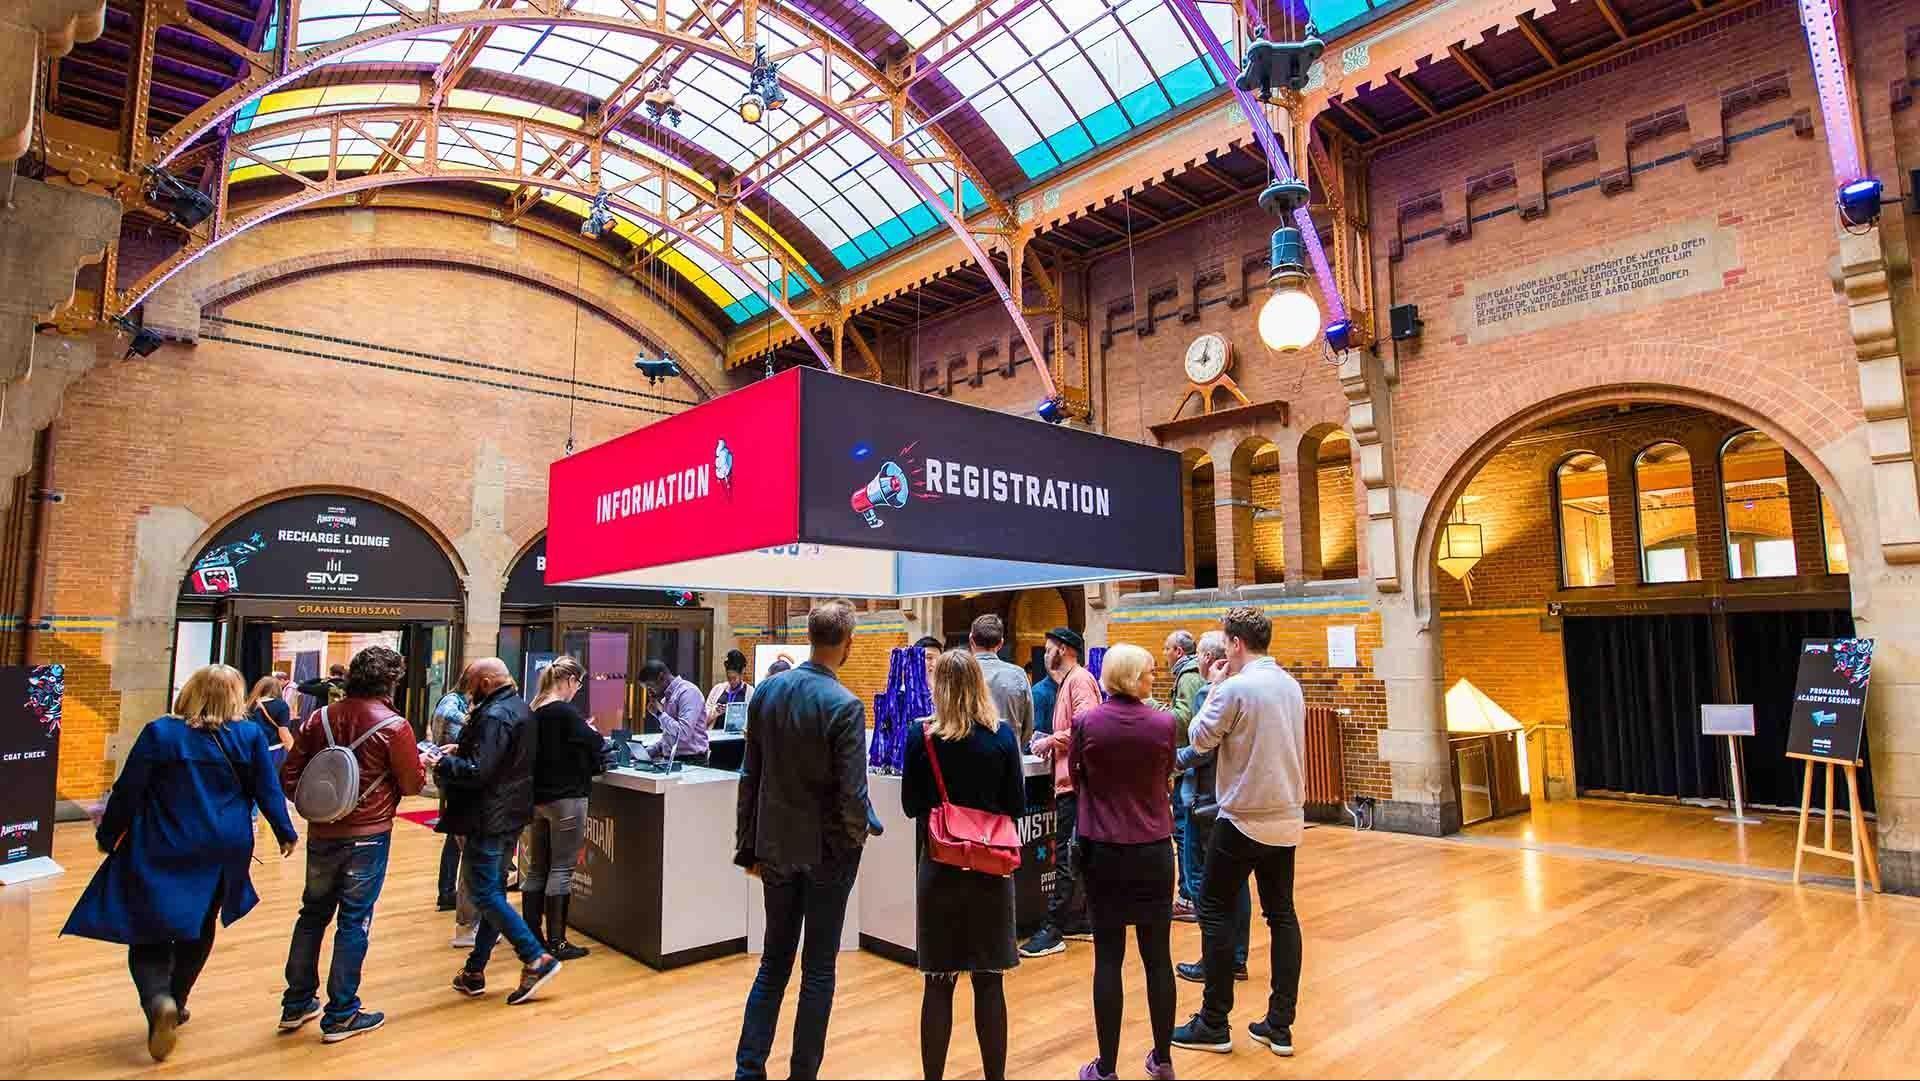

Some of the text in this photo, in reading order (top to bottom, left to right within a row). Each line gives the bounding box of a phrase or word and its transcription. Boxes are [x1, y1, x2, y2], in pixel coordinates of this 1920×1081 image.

[596, 463, 710, 525] INFORMATION
[926, 458, 1111, 518] REGISTRATION
[278, 529, 390, 548] RECHARGE LOUNGE
[306, 572, 359, 585] SMP
[1797, 694, 1861, 705] ACADEMY SESSIONS
[3, 751, 46, 761] COAT CHECK
